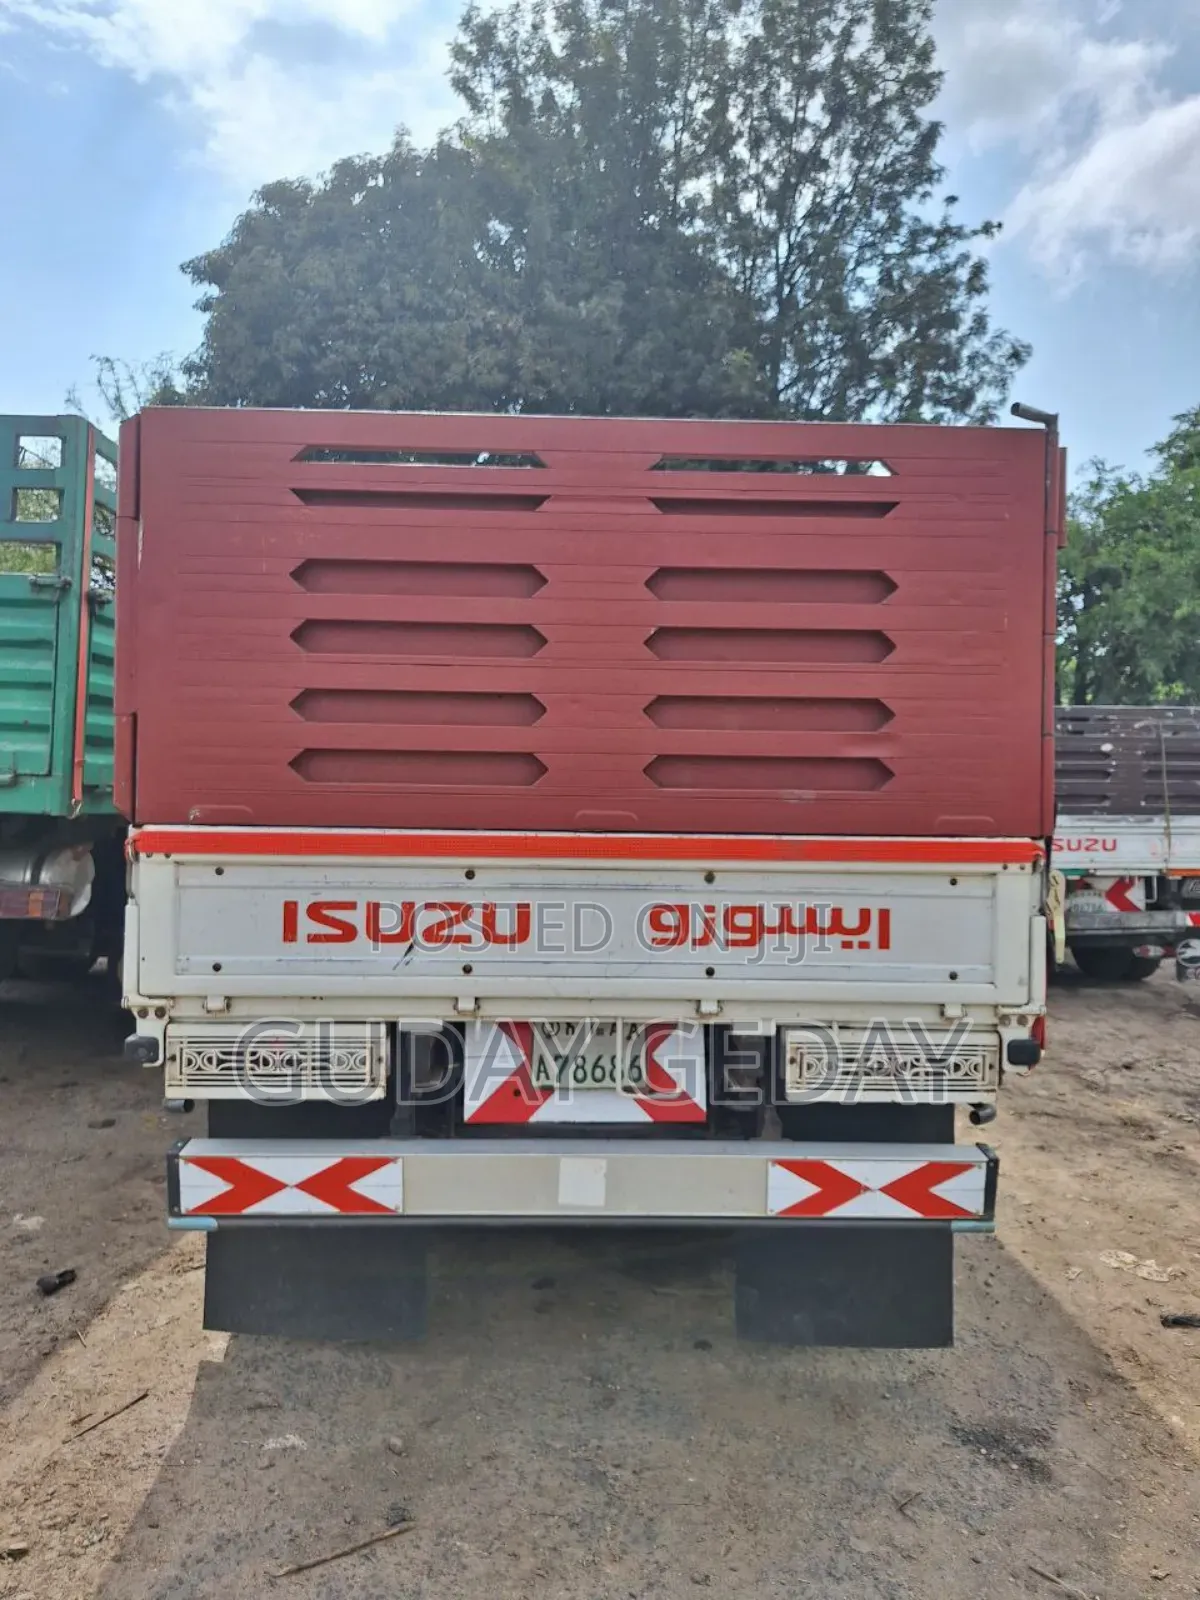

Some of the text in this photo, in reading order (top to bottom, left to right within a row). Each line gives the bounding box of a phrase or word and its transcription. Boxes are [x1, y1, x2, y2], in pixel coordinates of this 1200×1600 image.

[1052, 838, 1117, 852] SUZU
[282, 901, 531, 944] ISUZU
[535, 1054, 643, 1084] A78686
